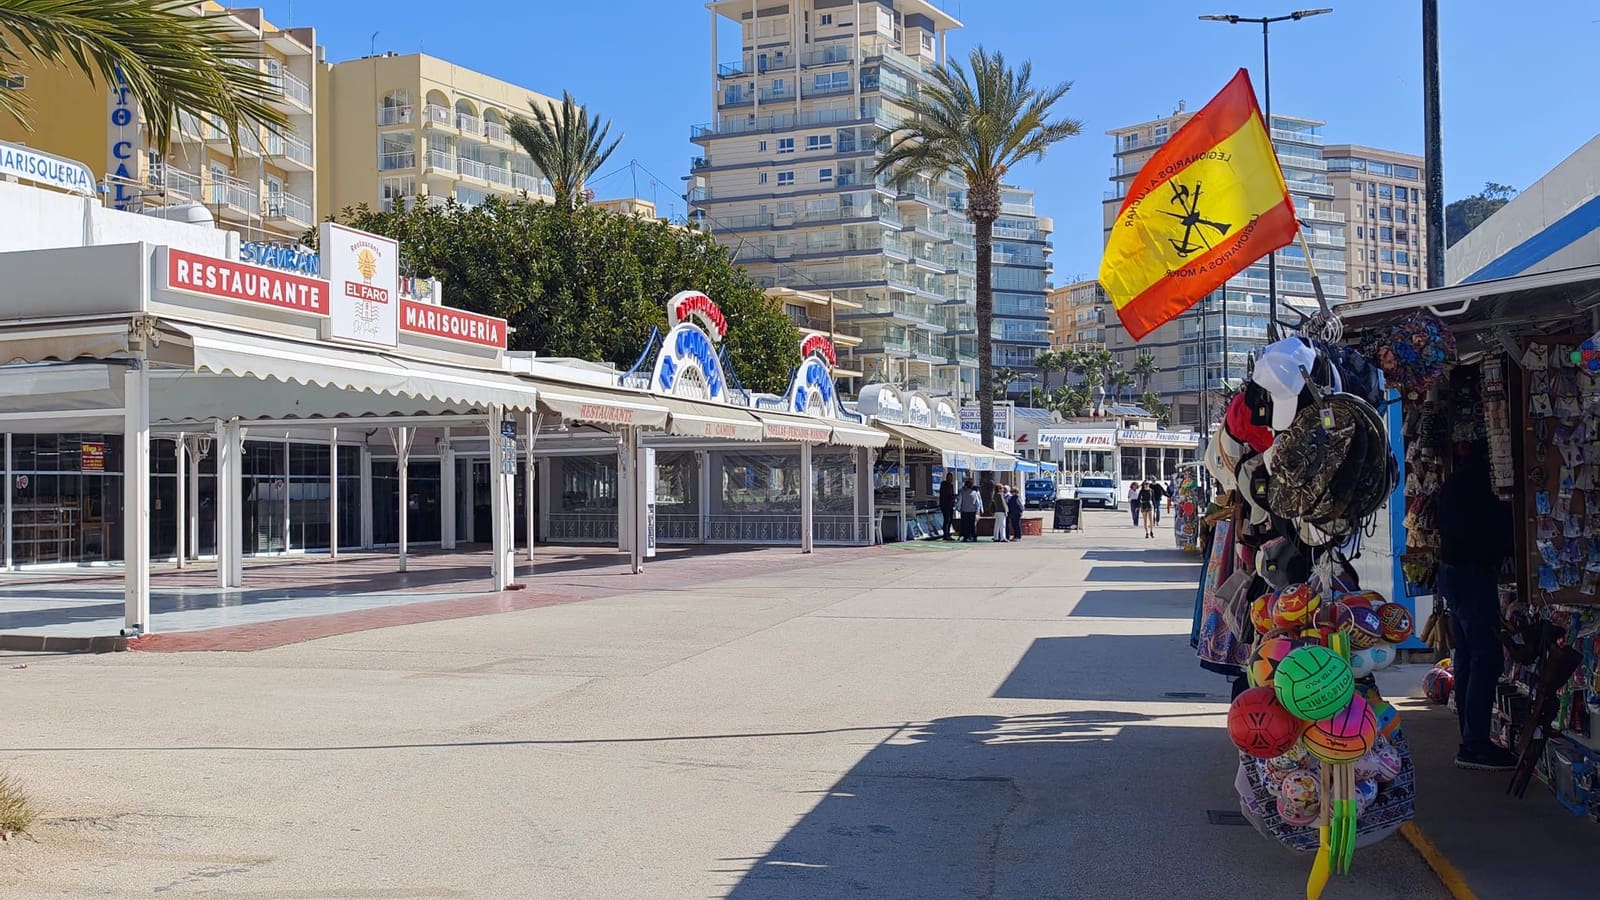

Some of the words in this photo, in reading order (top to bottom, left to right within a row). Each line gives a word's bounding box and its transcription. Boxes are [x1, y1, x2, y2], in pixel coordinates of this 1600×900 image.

[350, 240, 382, 257] Restaurante
[177, 259, 320, 309] RESTAURANTE
[347, 284, 360, 297] EL
[361, 287, 388, 302] FARO
[406, 306, 498, 344] MARISQUERÍA
[676, 296, 729, 336] RESTAURANTE
[580, 404, 634, 422] RESTAURANTE
[1085, 436, 1110, 445] BAYDAL
